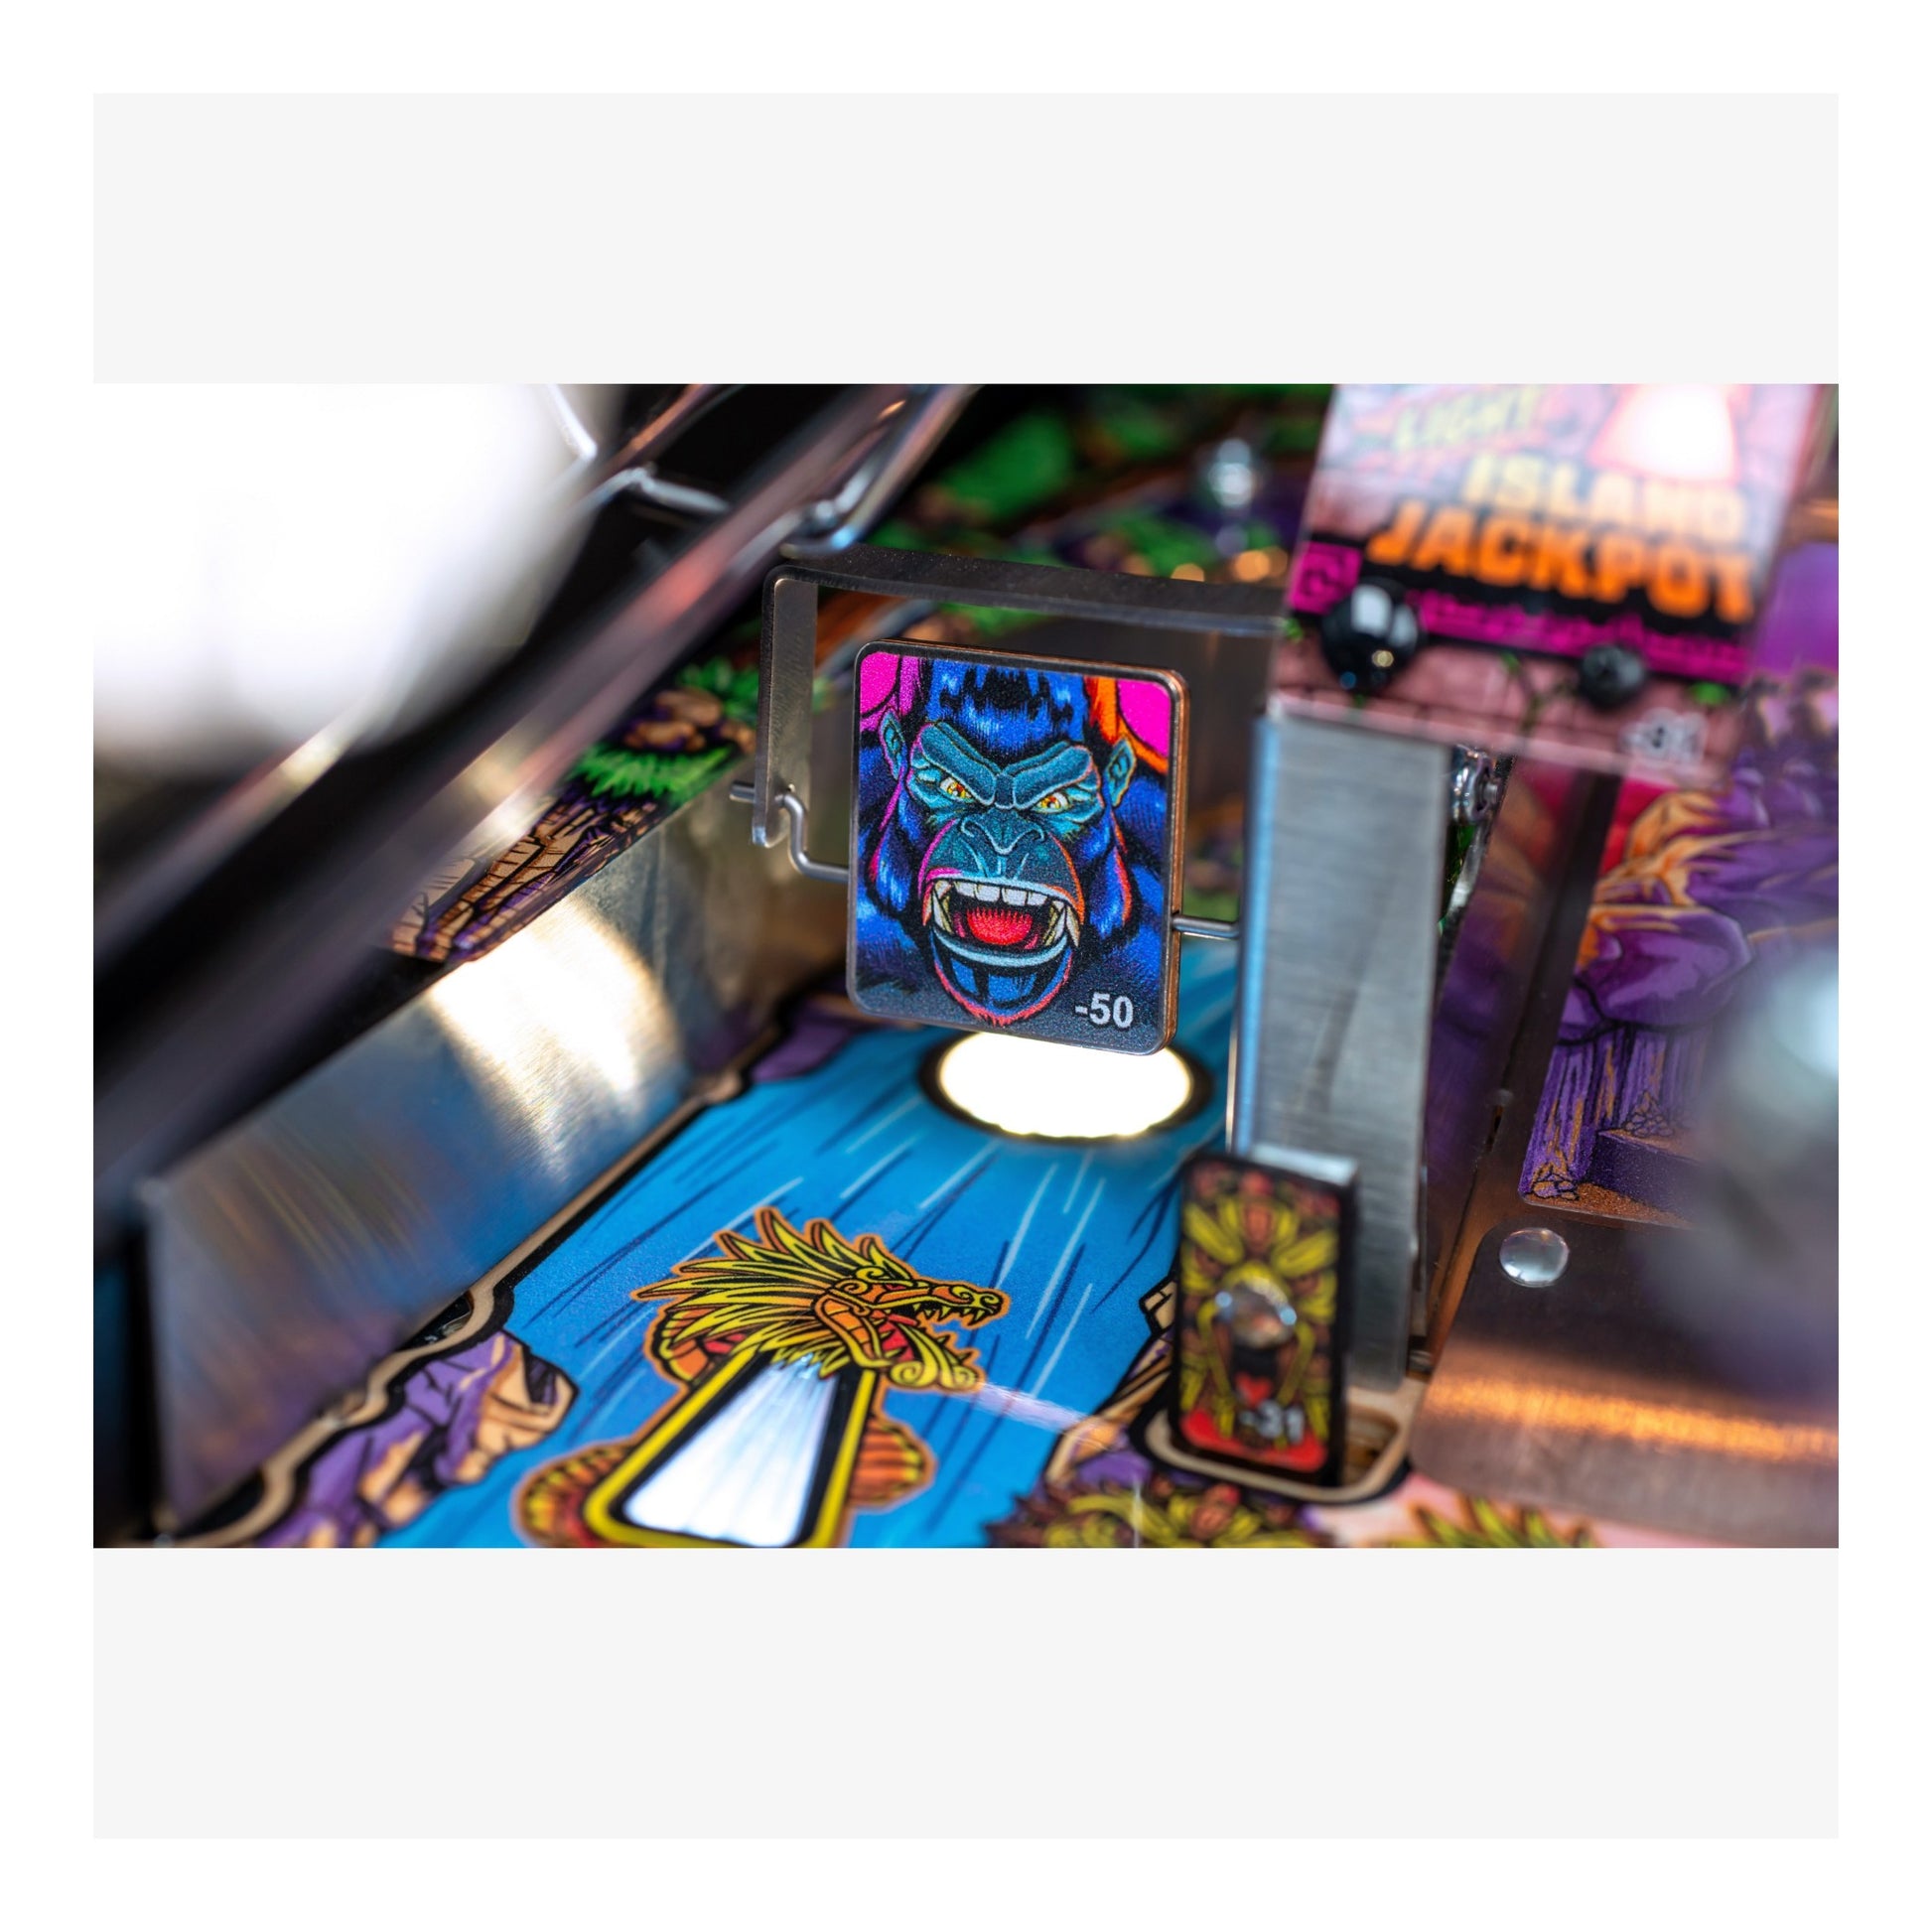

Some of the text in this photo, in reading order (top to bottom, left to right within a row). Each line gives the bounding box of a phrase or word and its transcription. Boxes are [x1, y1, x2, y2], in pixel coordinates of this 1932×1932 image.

[1460, 454, 1753, 546] ISLAND
[1364, 498, 1755, 623] JACKPOT
[1074, 992, 1134, 1029] -50
